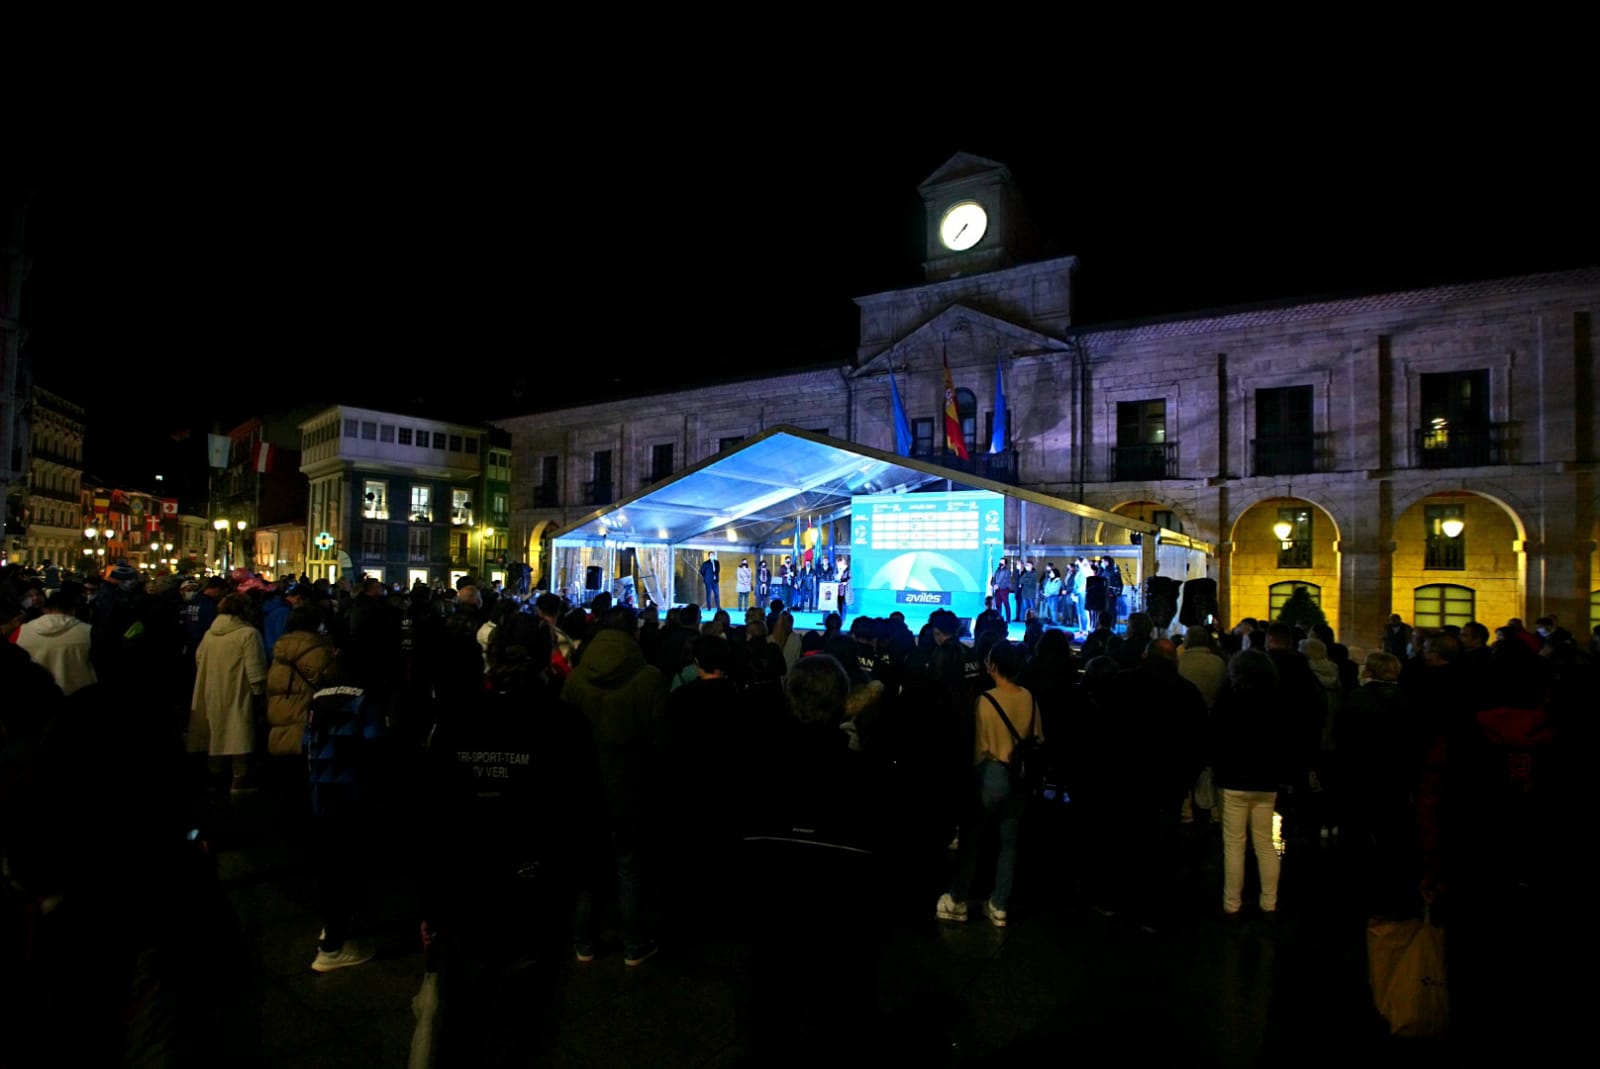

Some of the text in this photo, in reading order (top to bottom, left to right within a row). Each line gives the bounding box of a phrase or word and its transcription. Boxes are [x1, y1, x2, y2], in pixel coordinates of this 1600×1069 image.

[456, 751, 530, 765] TRI-SPORT-TEAM
[472, 765, 510, 779] TV VERL
